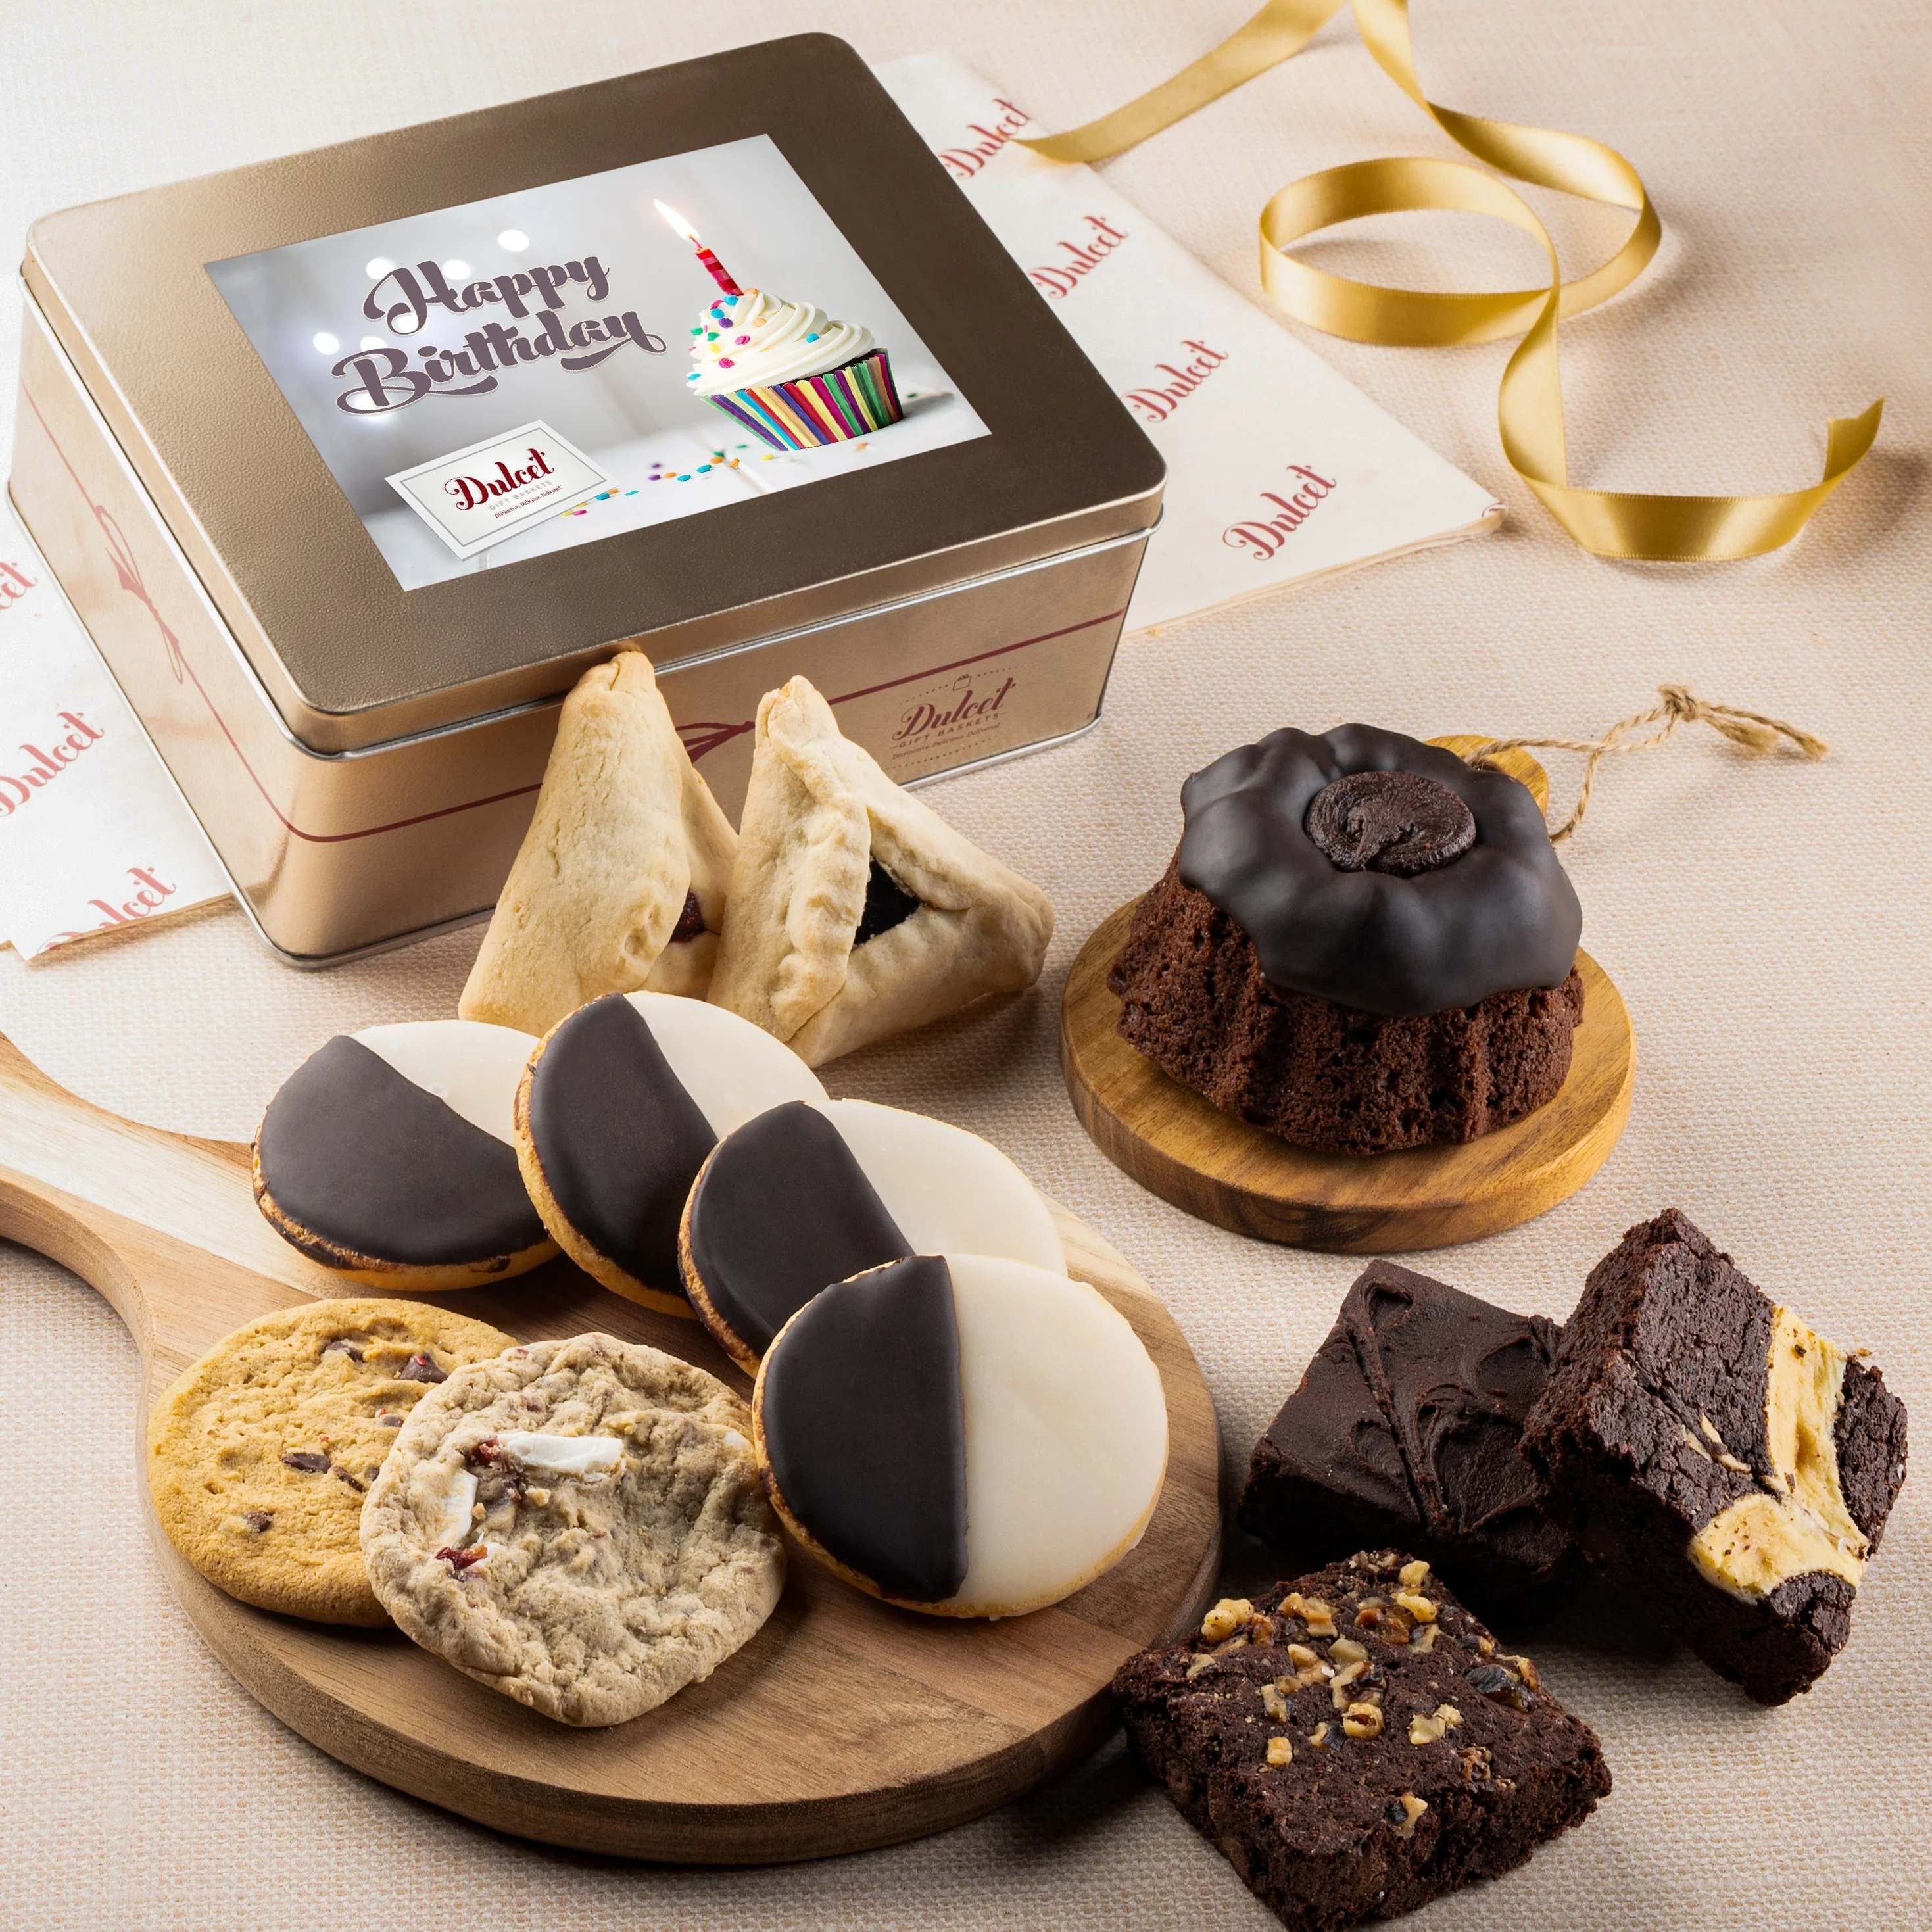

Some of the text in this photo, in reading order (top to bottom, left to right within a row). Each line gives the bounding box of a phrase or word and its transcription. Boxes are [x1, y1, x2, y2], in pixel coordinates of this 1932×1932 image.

[362, 256, 610, 335] Happy
[1027, 215, 1128, 299] Dulcet
[331, 310, 667, 416] Birthday
[1119, 339, 1228, 423] Dulcet
[444, 448, 554, 511] Dulcet
[489, 480, 552, 511] GIFT BASKETS
[494, 485, 563, 519] Distinctive. Delicious. Delivered.
[1222, 464, 1337, 561] Dulcet
[892, 677, 1017, 740] Dulcet
[899, 713, 999, 748] GIFT BASKETS
[37, 867, 176, 954] lcet
